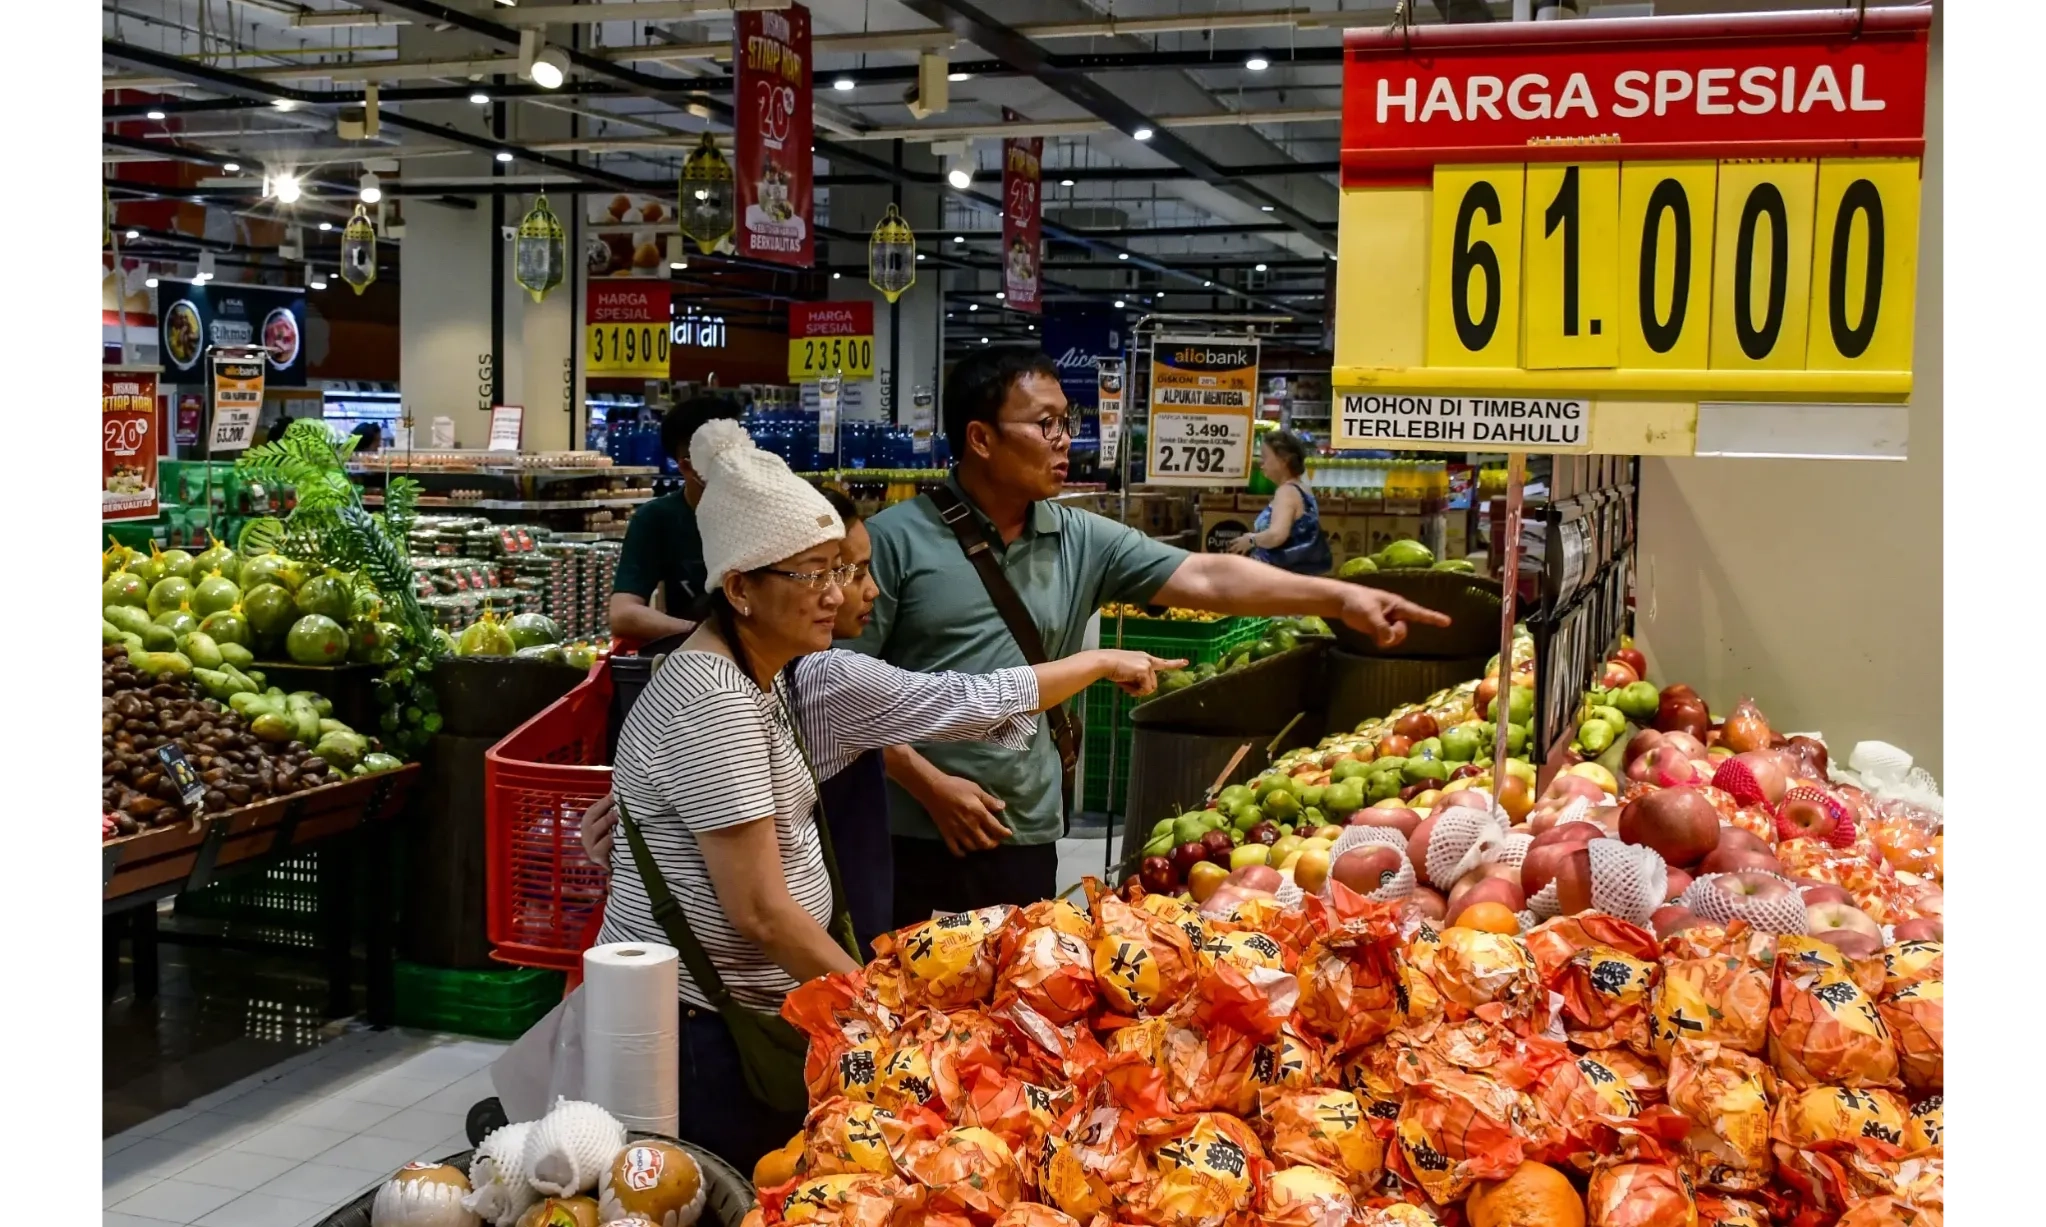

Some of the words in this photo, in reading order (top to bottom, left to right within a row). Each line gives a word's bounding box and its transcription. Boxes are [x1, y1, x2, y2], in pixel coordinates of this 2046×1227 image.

[1376, 73, 1599, 123] HARGA
[1613, 63, 1886, 118] SPESIAL
[1451, 165, 1885, 360] 61.000
[598, 293, 648, 305] HARGA
[594, 307, 652, 320] SPESIAL
[808, 310, 853, 321] HARGA
[806, 322, 856, 334] SPESIAL
[804, 339, 871, 370] 23500
[1174, 347, 1248, 366] allobank
[478, 353, 493, 411] EGGS
[1163, 389, 1202, 404] ALPUKAT
[1203, 391, 1244, 406] MENTEGA
[1344, 396, 1432, 415] MOHON
[1439, 399, 1462, 416] DI
[1469, 400, 1581, 419] TIMBANG
[1185, 422, 1230, 438] 3.490
[1343, 418, 1465, 440] TERLEBIH
[1472, 422, 1580, 443] DAHULU
[1158, 445, 1226, 473] 2.792
[102, 500, 153, 513] BERKUALITAS
